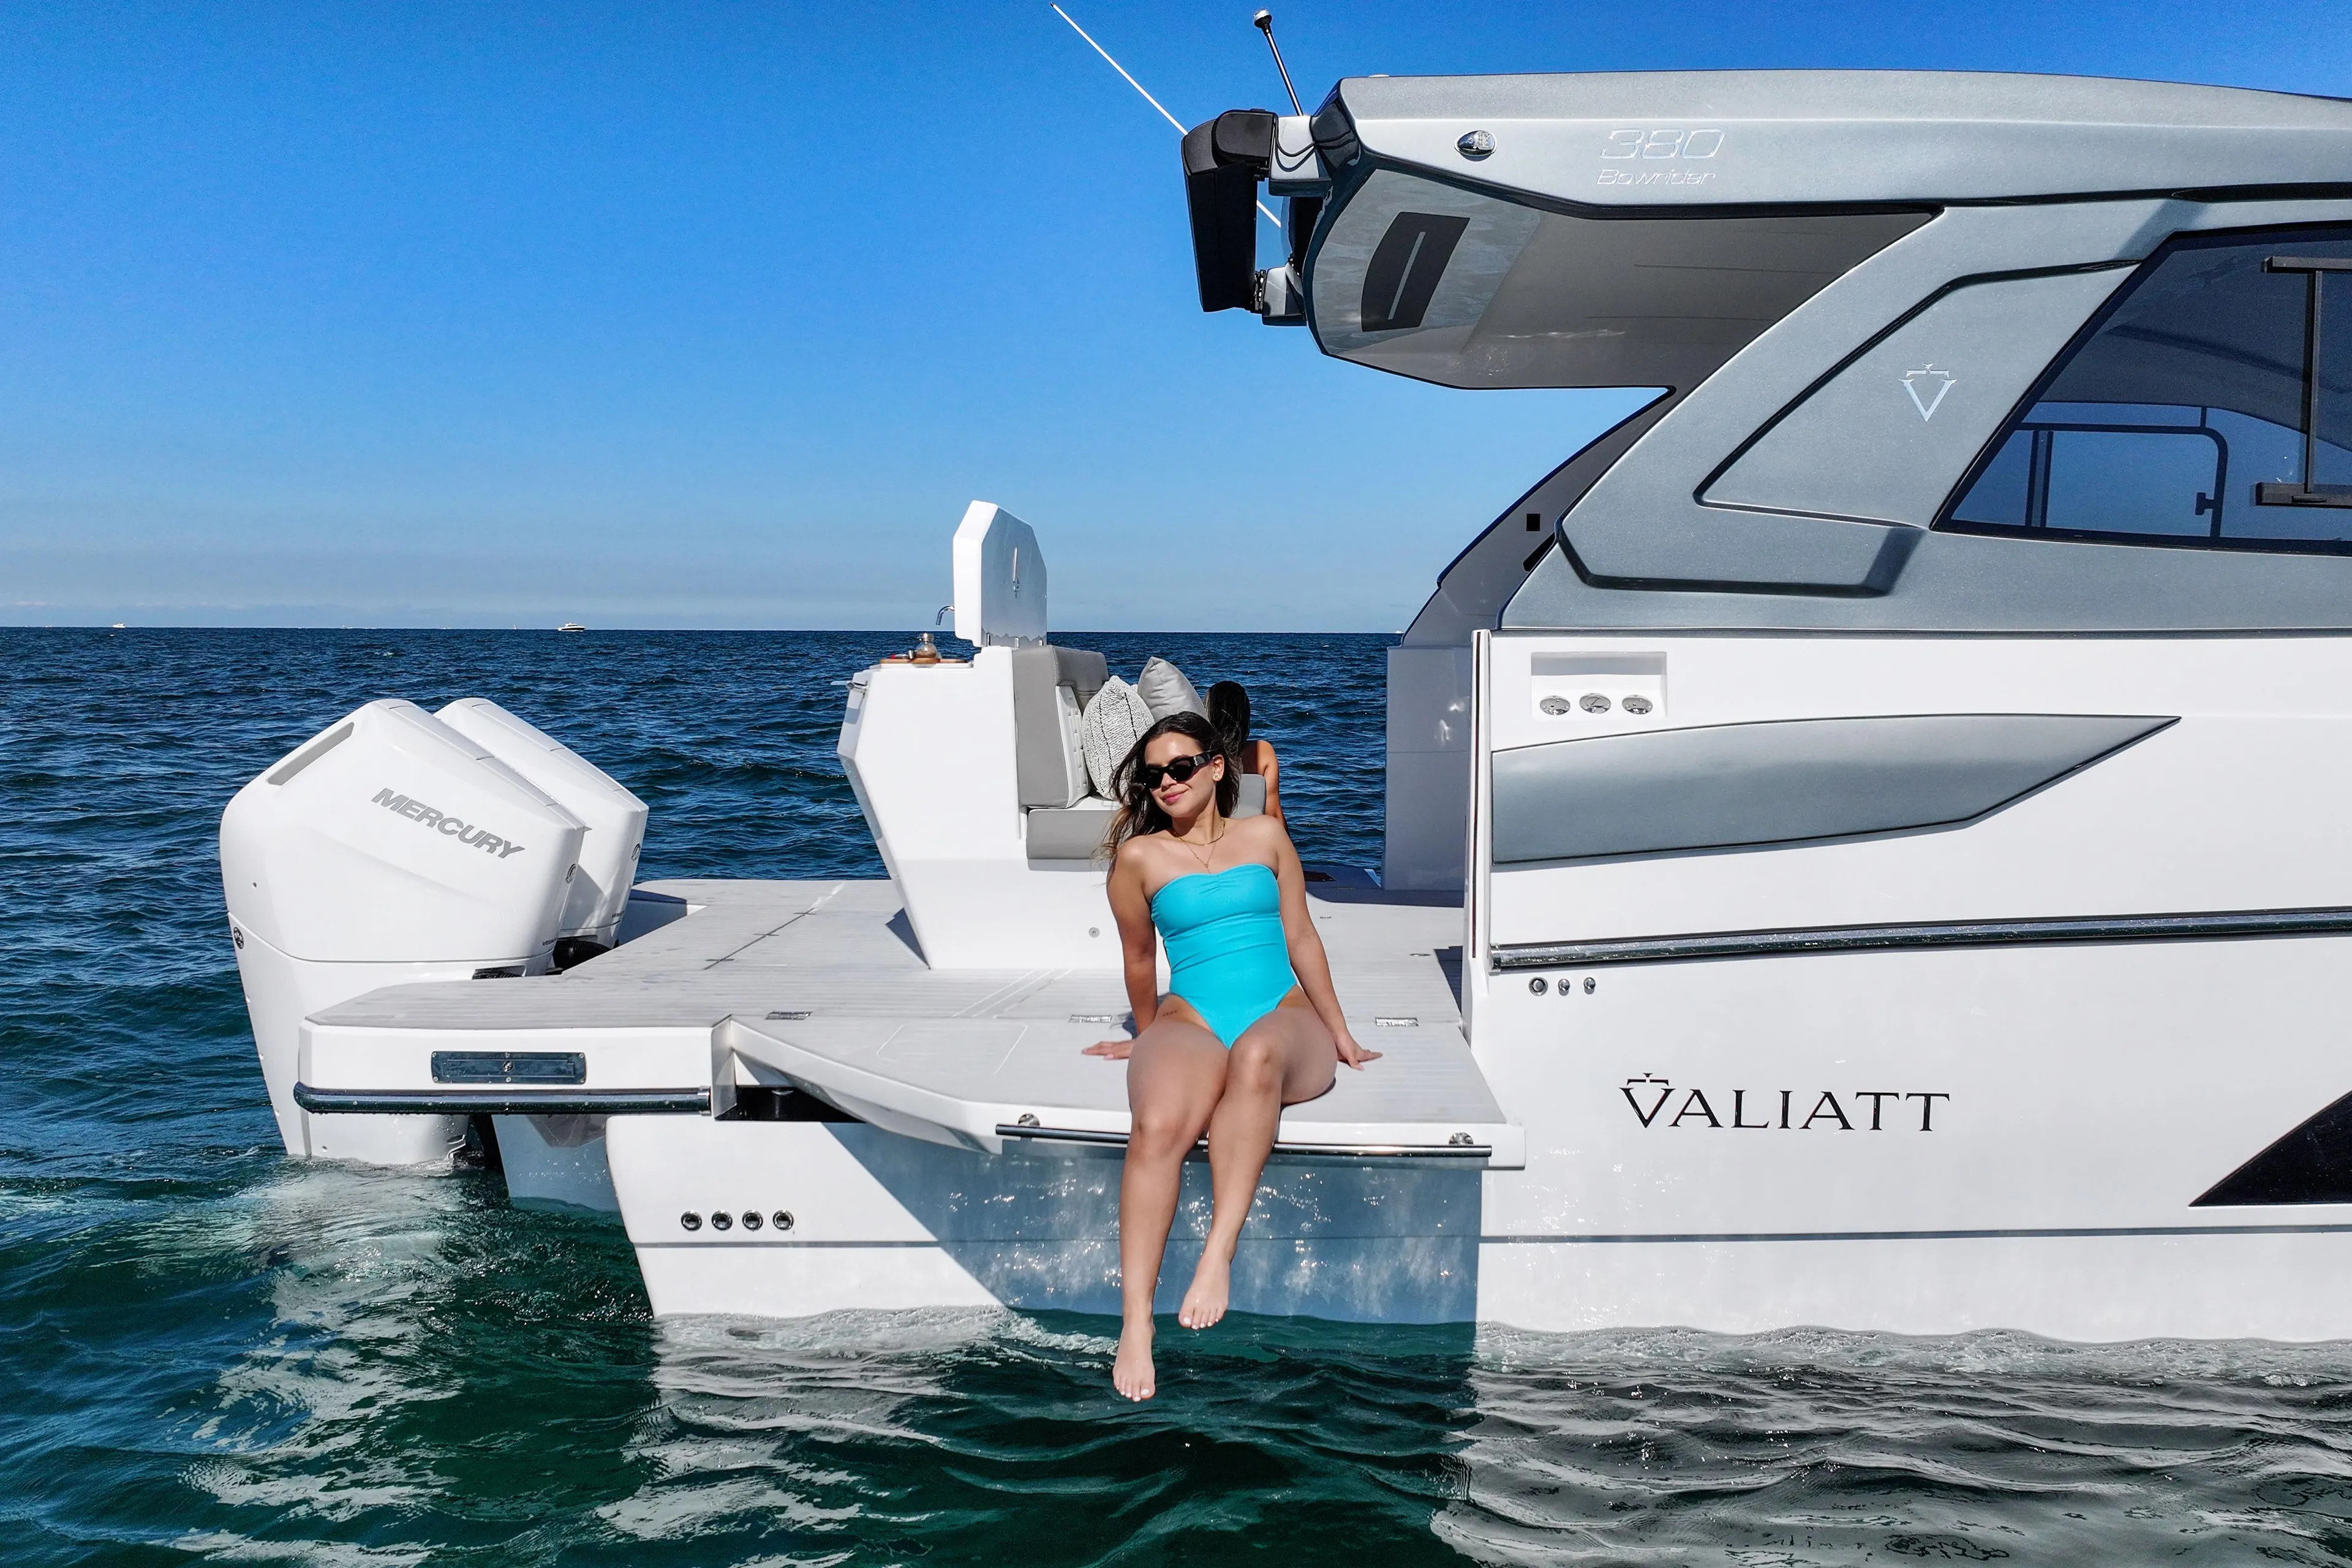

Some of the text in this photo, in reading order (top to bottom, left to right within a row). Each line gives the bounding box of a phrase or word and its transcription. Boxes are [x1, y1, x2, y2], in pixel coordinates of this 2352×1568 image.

[1599, 127, 1725, 159] 380
[1597, 168, 1716, 185] Bowrider
[371, 787, 526, 859] MERCURY
[1619, 1072, 1950, 1132] VALIATT
